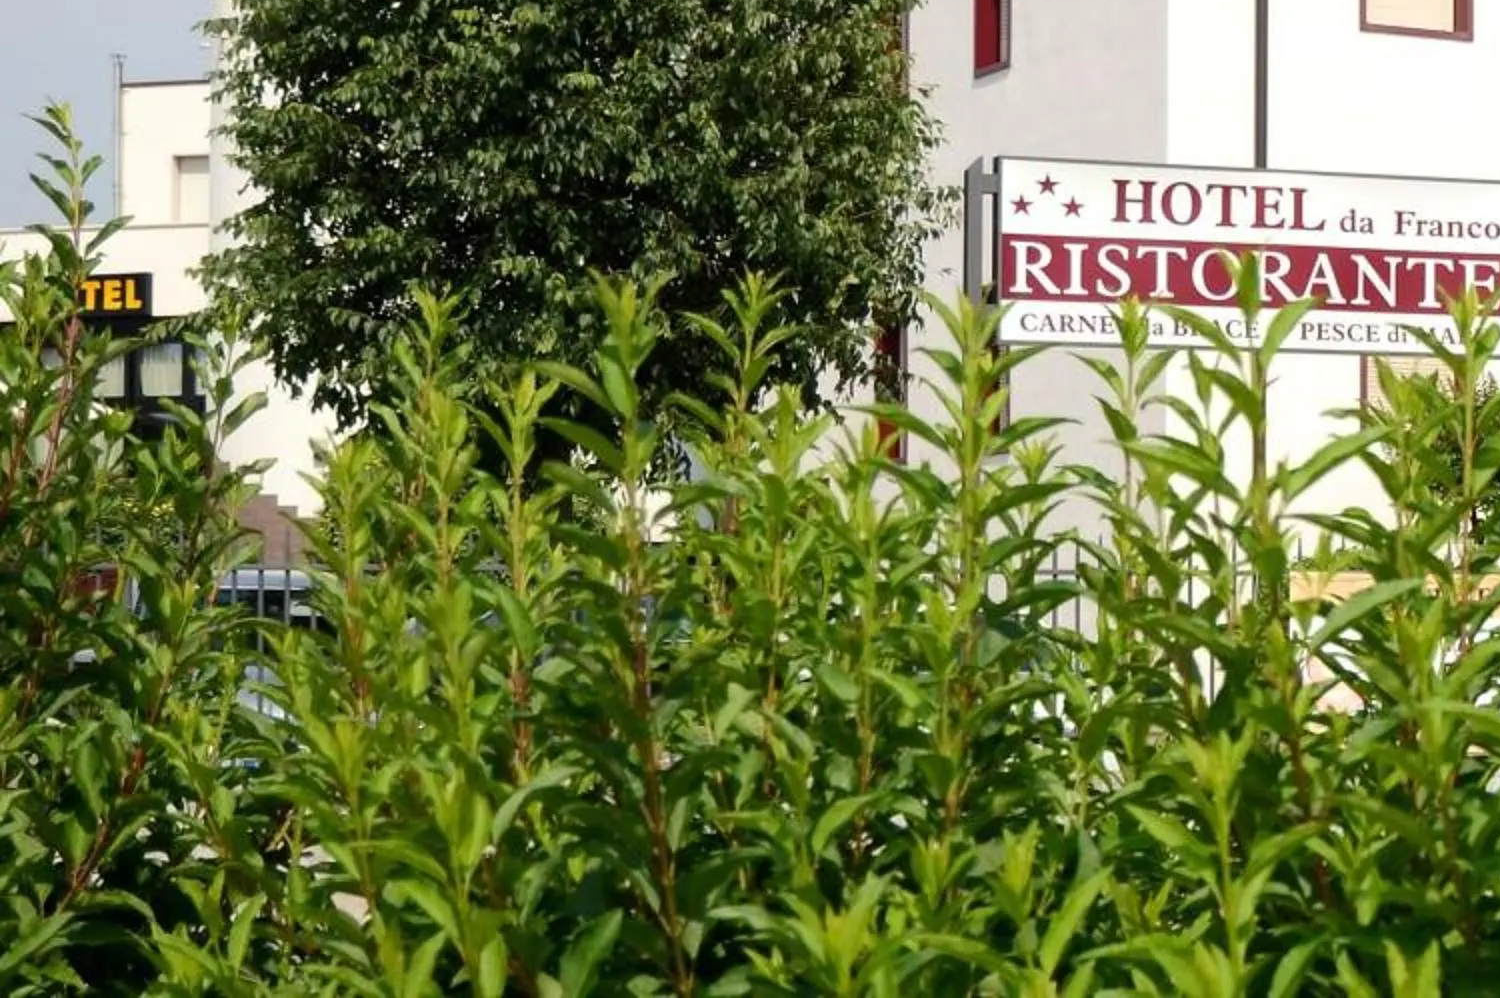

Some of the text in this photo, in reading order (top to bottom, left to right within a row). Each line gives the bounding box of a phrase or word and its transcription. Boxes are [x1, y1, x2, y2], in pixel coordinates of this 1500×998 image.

[1109, 178, 1327, 232] HOTEL
[1338, 208, 1375, 235] da
[79, 279, 143, 311] TEL
[1019, 313, 1115, 335] CARNE
[1300, 321, 1382, 344] PESCE
[1387, 323, 1407, 344] di
